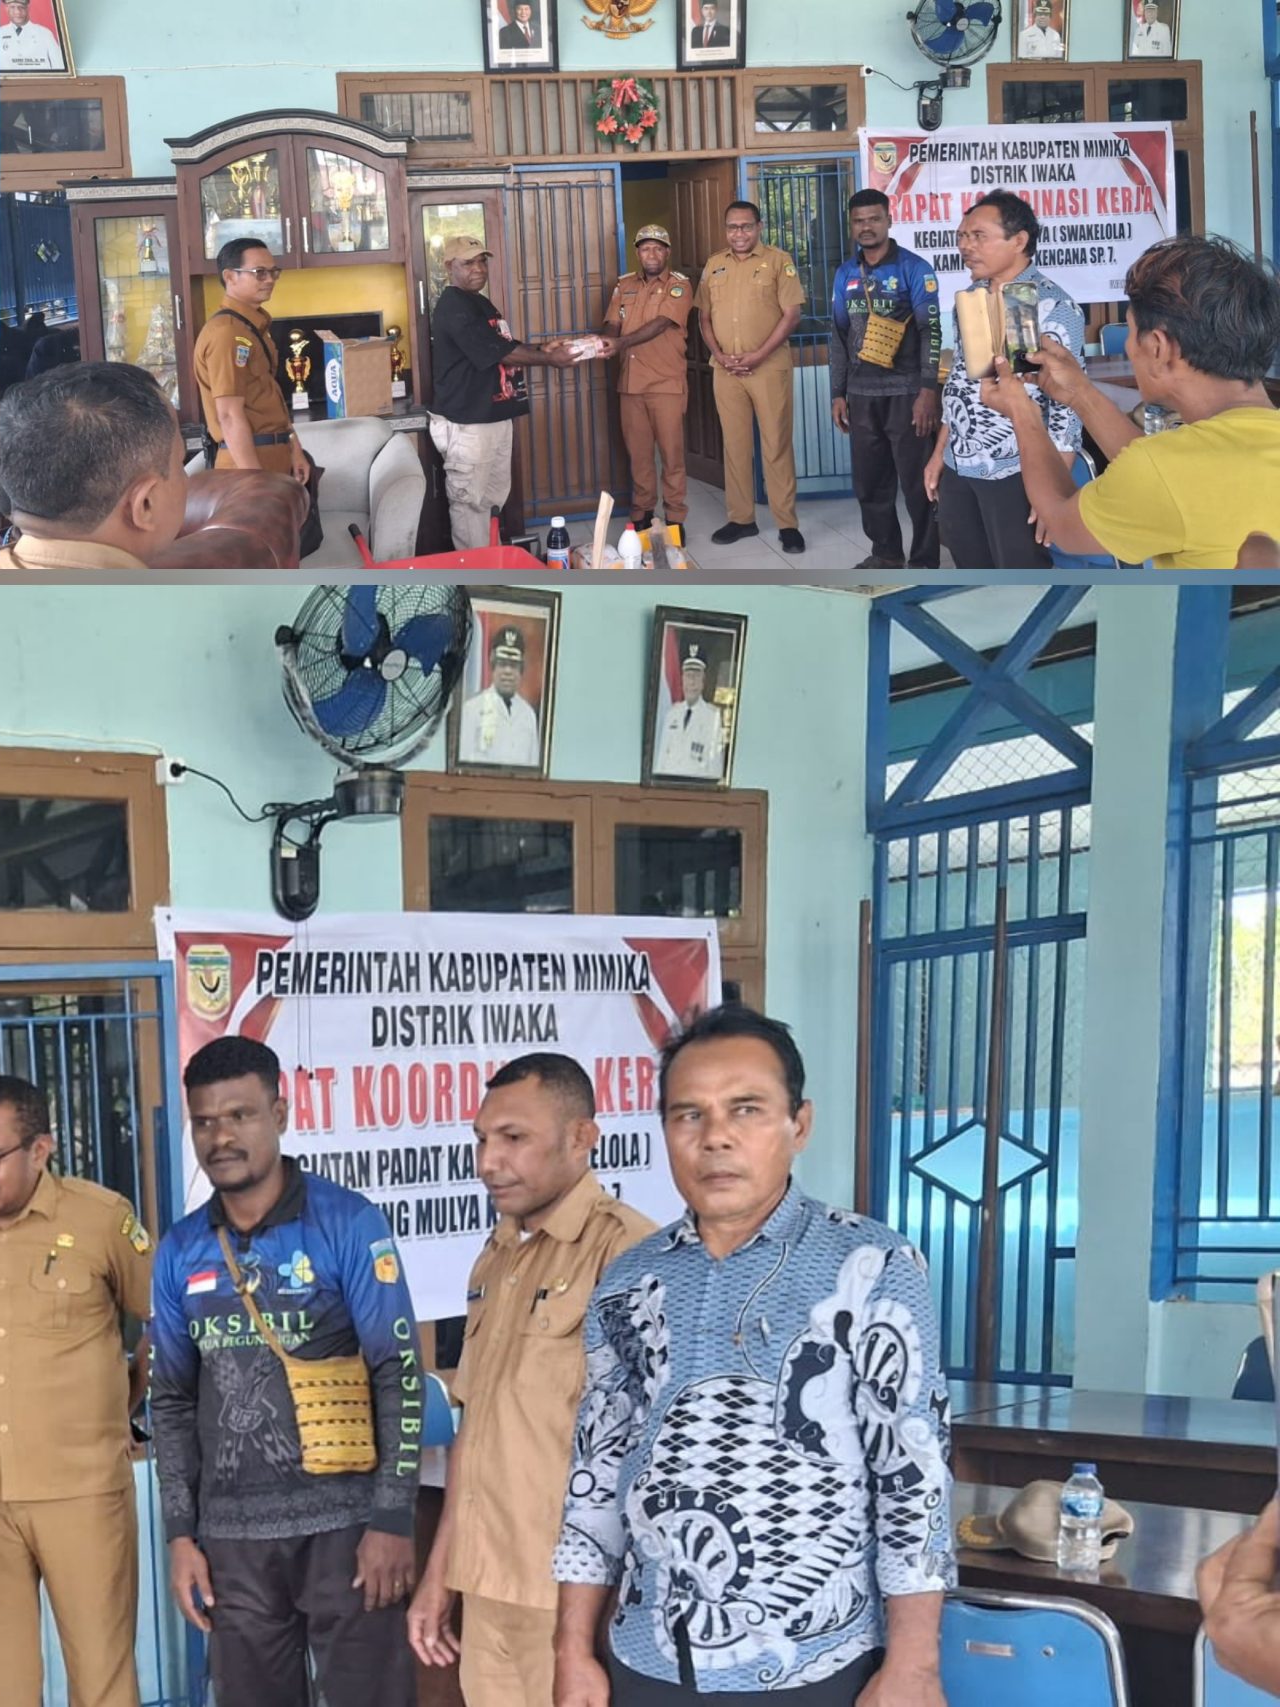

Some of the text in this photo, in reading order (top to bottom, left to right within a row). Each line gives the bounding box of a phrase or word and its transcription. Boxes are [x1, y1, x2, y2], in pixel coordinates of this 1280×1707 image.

[910, 139, 1130, 162] PEMERINTAH KABUPATEN MIMIKA
[971, 163, 1075, 184] DISTRIK IWAKA
[888, 192, 952, 222] RAPAT
[1097, 186, 1154, 214] KERJA
[1060, 223, 1125, 242] SWAKELOLA
[1035, 247, 1087, 266] KENCANA
[1090, 247, 1105, 263] SP.
[256, 952, 651, 995] PEMERINTAH KABUPATEN MIMIKA
[372, 1003, 559, 1048] DISTRIK IWAKA
[594, 1056, 654, 1113] KER
[377, 1145, 443, 1187] PADAT
[415, 1194, 481, 1236] MULYA
[392, 1317, 422, 1478] OKSIBIL
